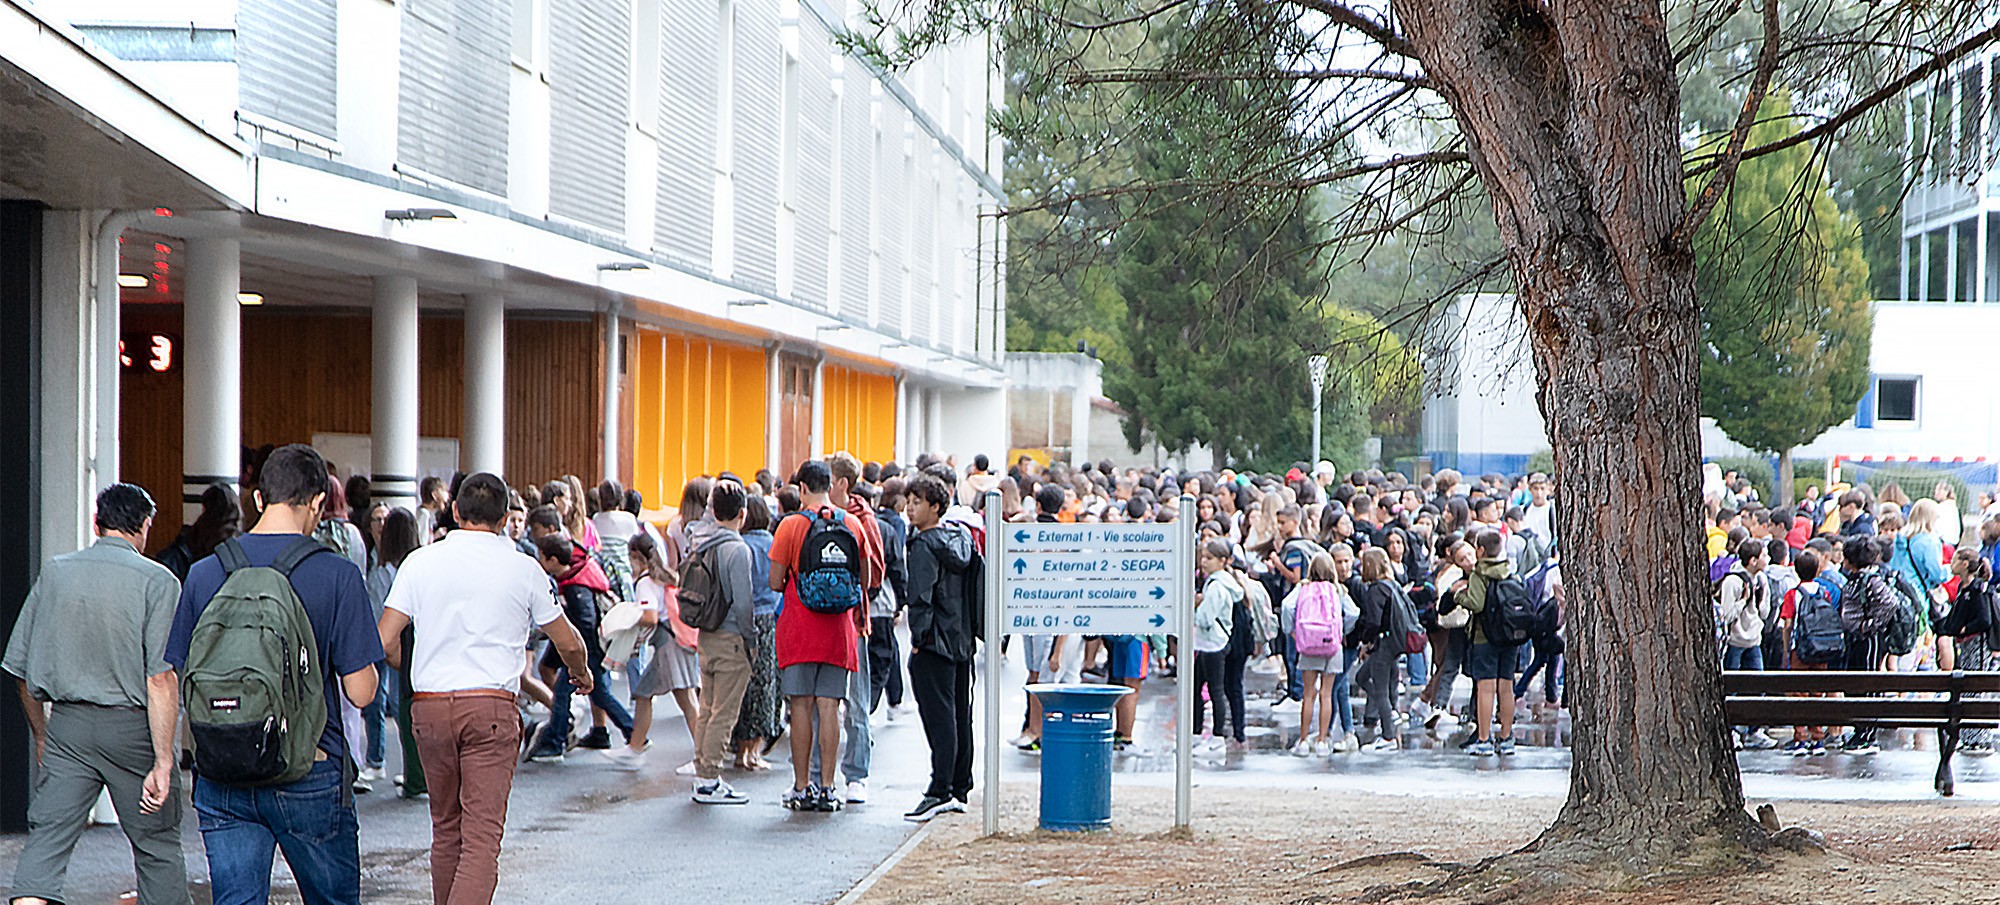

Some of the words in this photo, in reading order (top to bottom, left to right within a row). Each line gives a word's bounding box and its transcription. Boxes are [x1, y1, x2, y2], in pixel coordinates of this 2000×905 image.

[1037, 530, 1083, 543] Externat
[1087, 530, 1092, 543] 1
[1103, 530, 1120, 543] Vie
[1122, 530, 1165, 543] scolaire
[1042, 559, 1096, 572] Externat
[1100, 559, 1109, 572] 2
[1121, 559, 1165, 572] SEGPA
[1013, 587, 1084, 599] Restaurant
[1087, 587, 1137, 599] scolaire
[1013, 614, 1038, 627] Bât.
[1042, 614, 1060, 627] G1
[1073, 614, 1091, 627] G2
